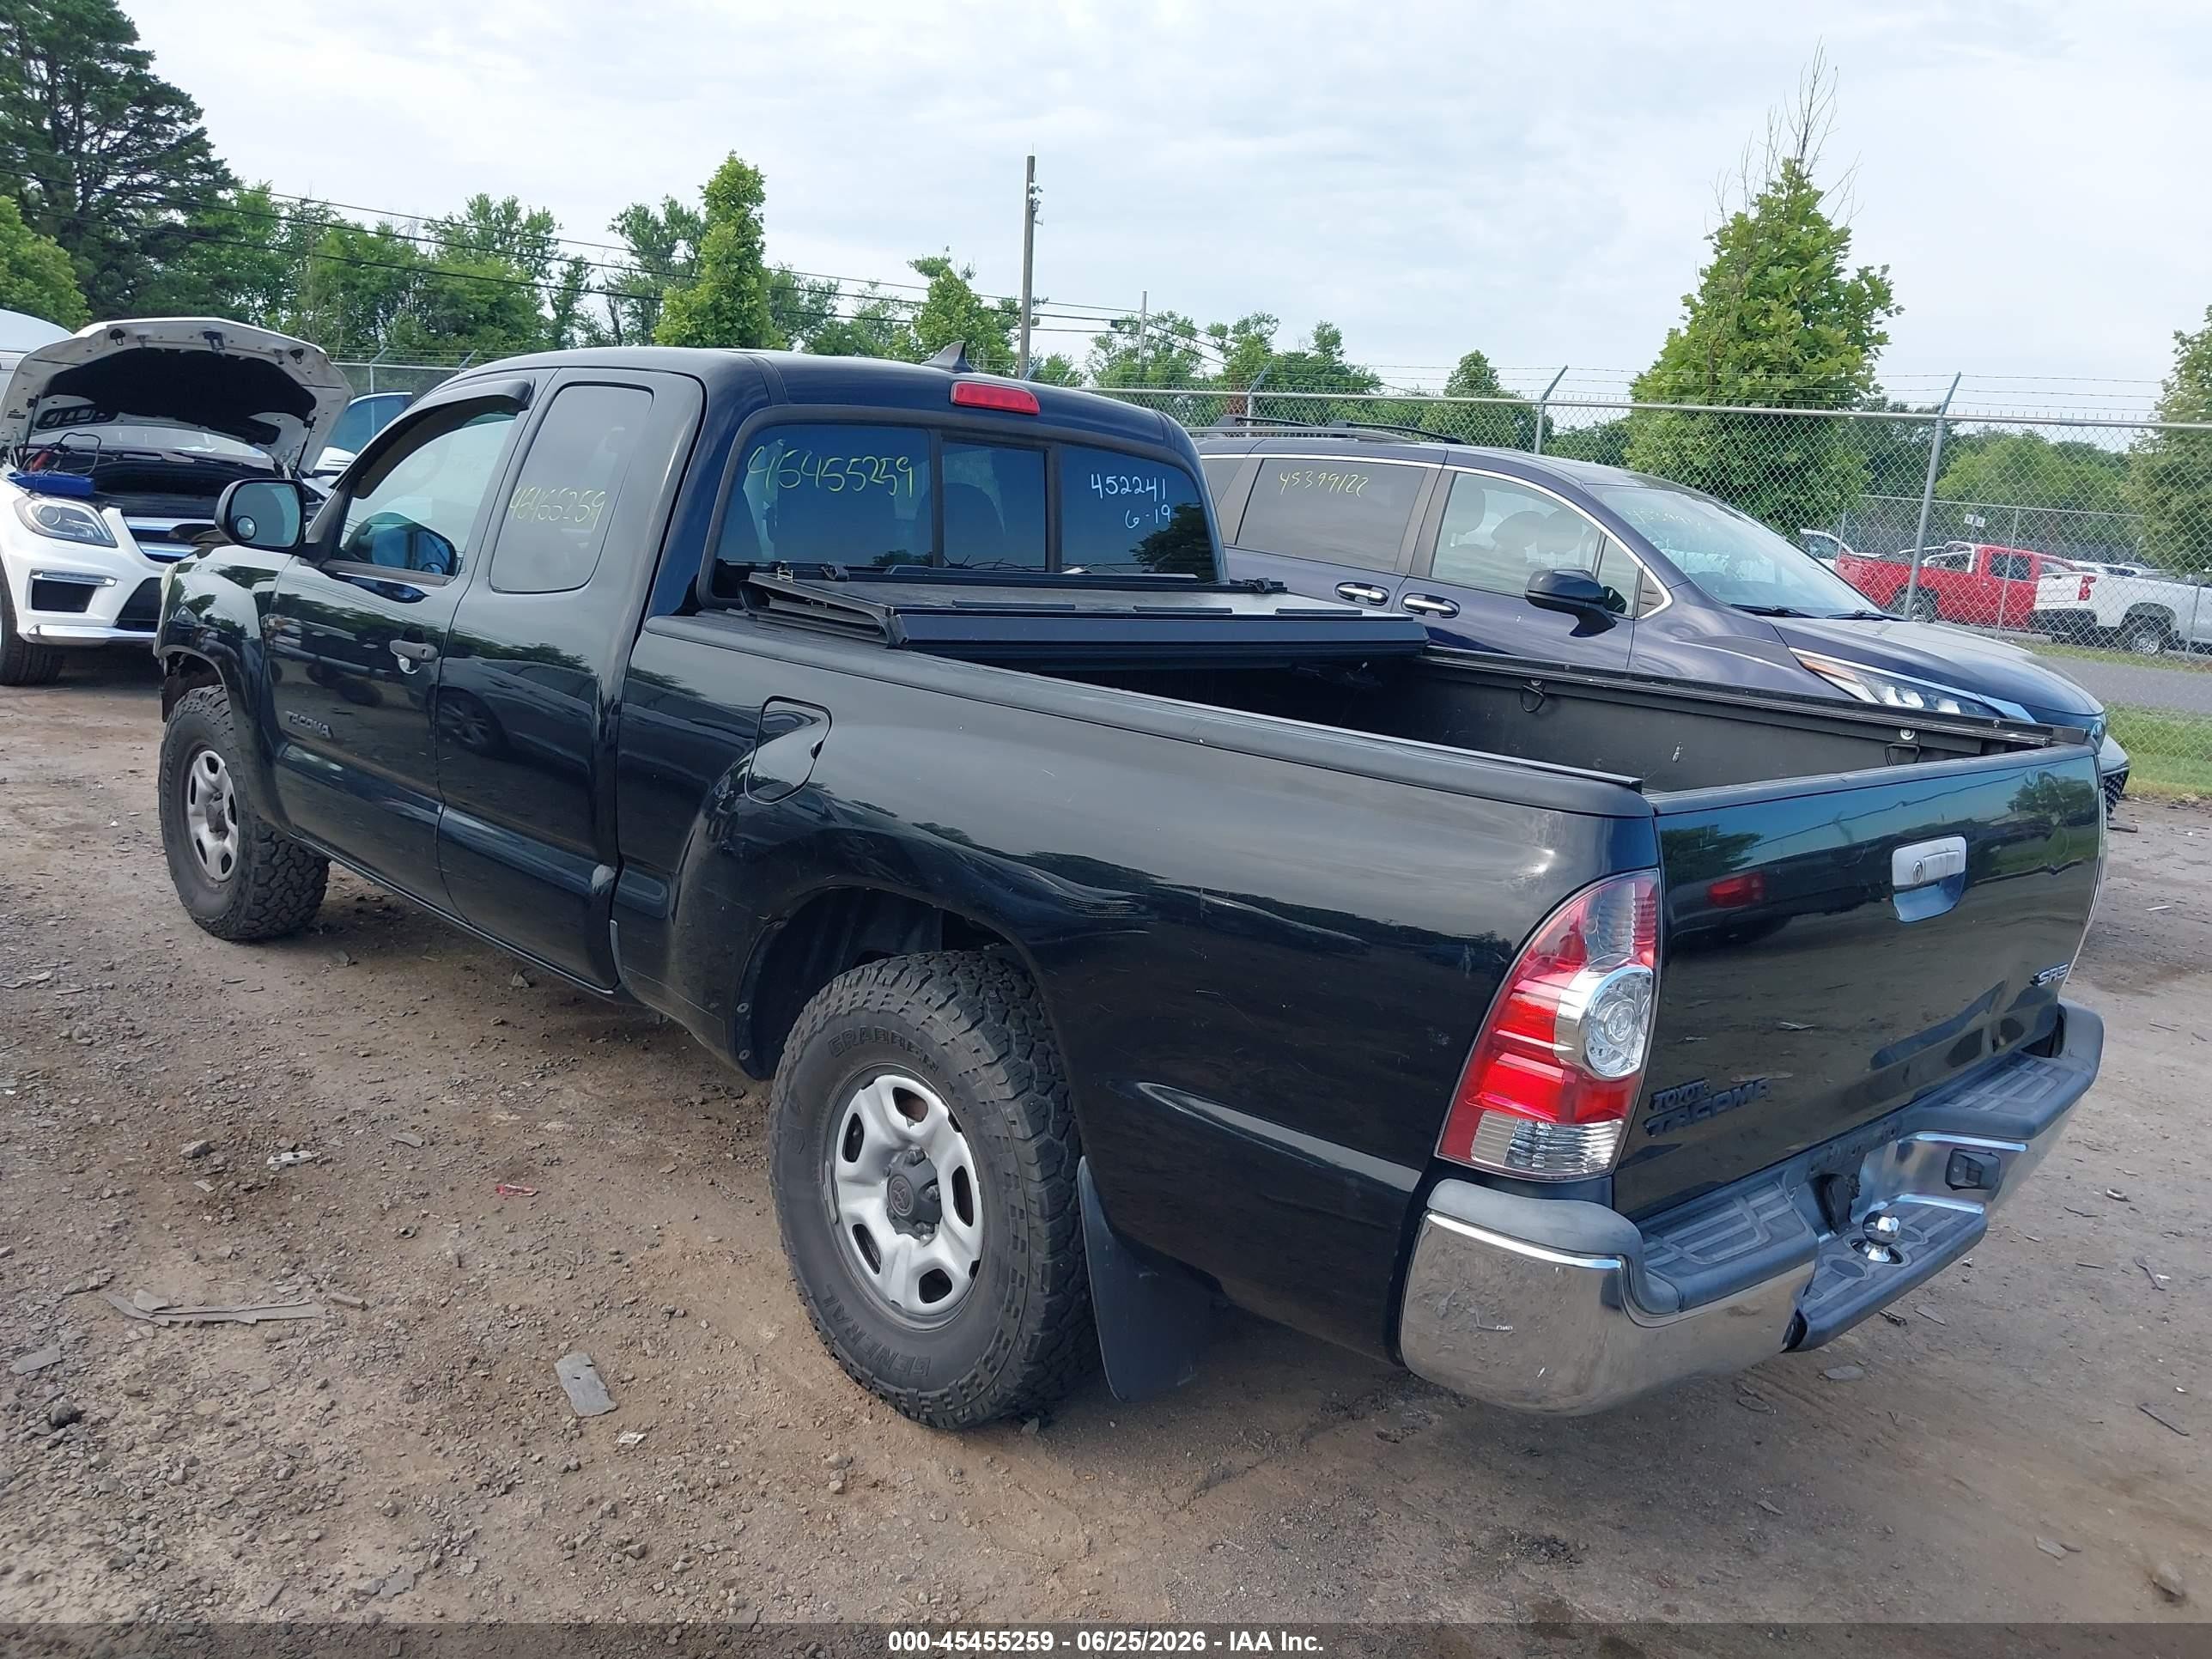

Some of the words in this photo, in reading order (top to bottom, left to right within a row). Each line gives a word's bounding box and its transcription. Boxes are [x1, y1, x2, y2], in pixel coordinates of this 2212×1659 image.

[747, 439, 914, 498] 45455259
[1091, 473, 1166, 502] 452241
[284, 710, 334, 738] TACOMA
[2034, 963, 2069, 987] SR5
